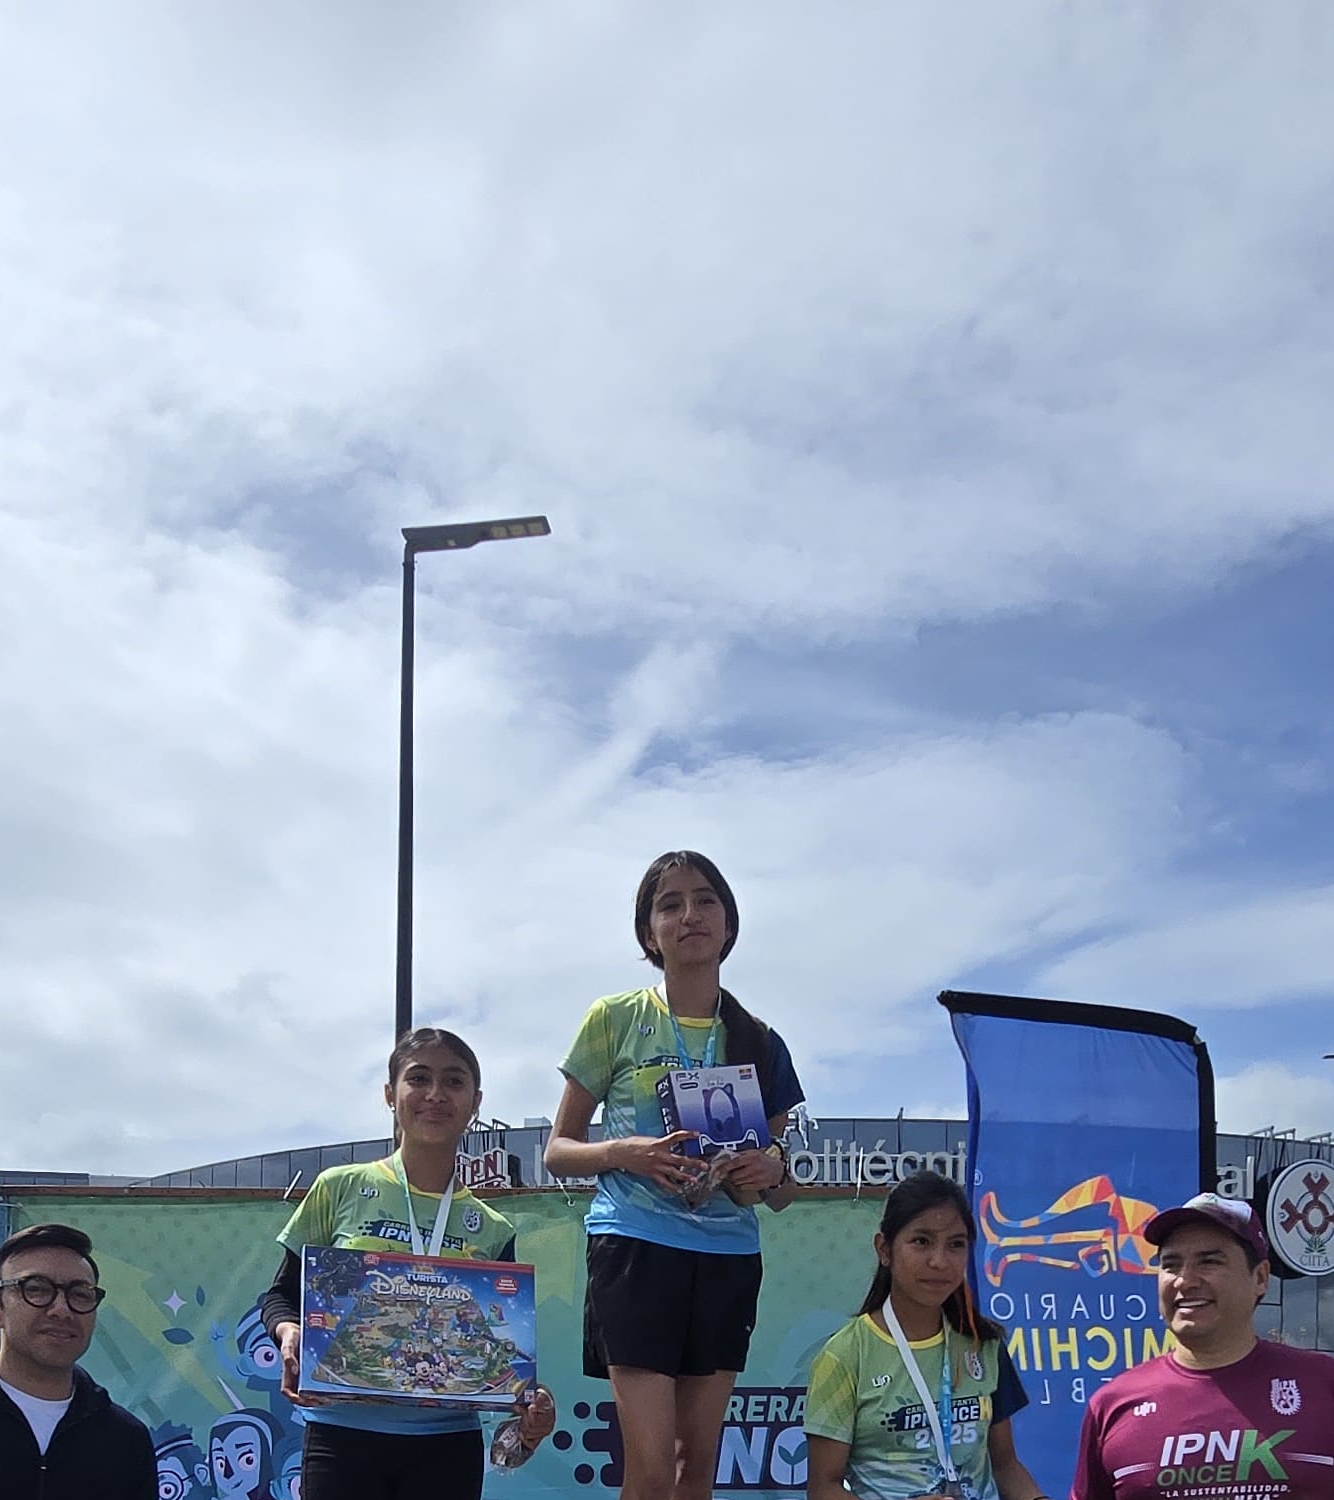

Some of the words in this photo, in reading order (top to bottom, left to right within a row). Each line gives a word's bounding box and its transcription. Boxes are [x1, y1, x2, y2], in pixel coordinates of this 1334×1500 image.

[405, 1273, 449, 1285] TURISTA
[915, 1423, 978, 1450] 225
[1157, 1464, 1233, 1487] ONCE
